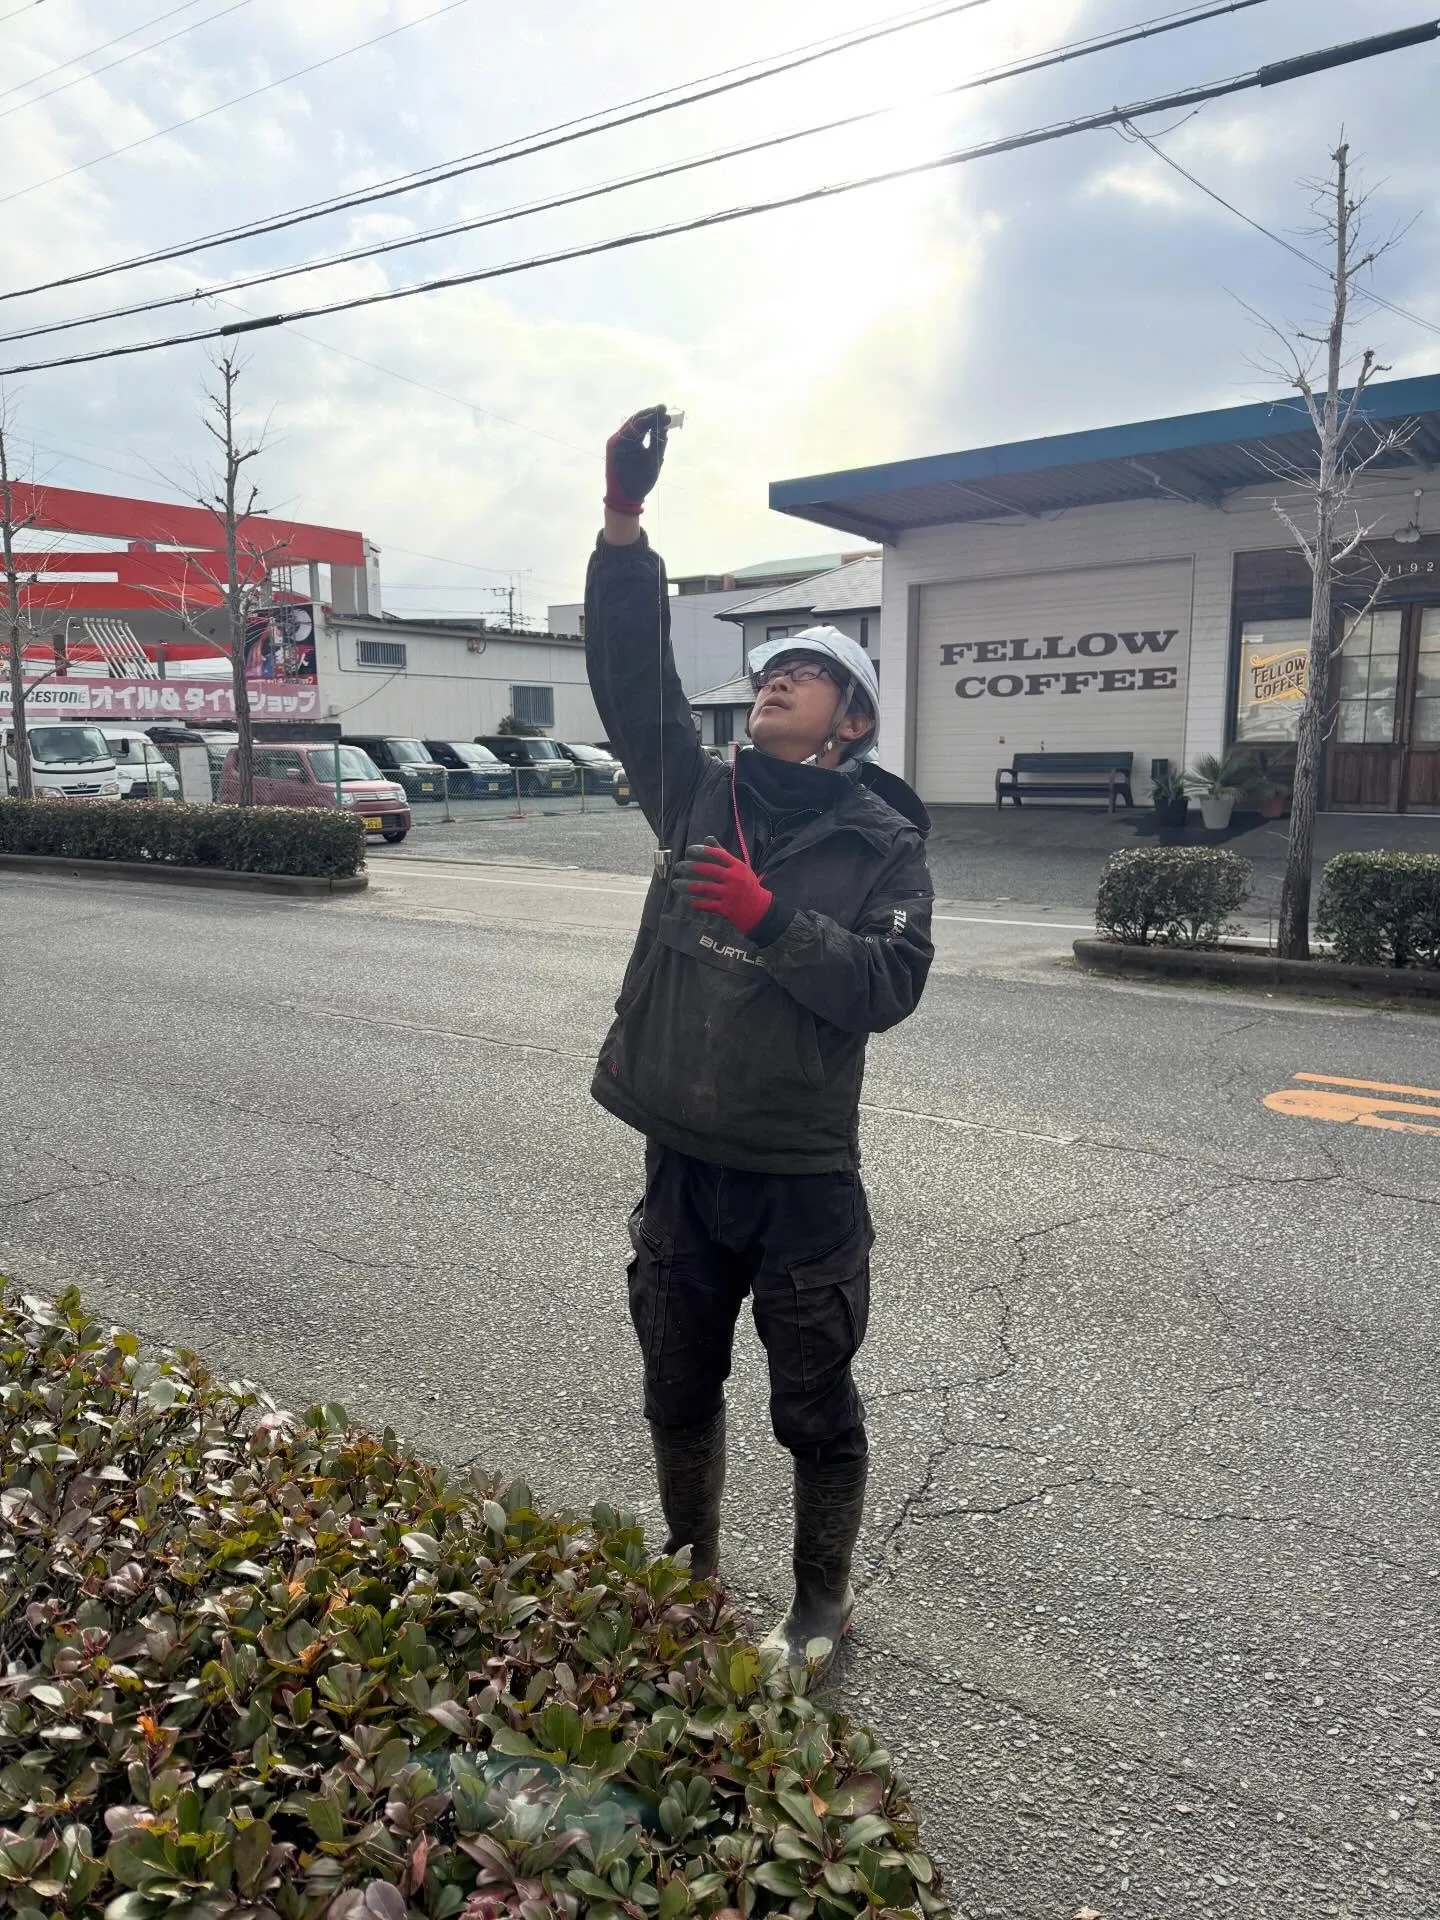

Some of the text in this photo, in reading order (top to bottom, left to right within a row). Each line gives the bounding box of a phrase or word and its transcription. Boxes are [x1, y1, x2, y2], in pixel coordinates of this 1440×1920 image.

[940, 630, 1179, 666] FELLOW
[955, 667, 1177, 699] COFFEE
[1251, 656, 1306, 685] FELLOW
[1255, 673, 1304, 699] COFFEE
[699, 935, 768, 968] BURTLE
